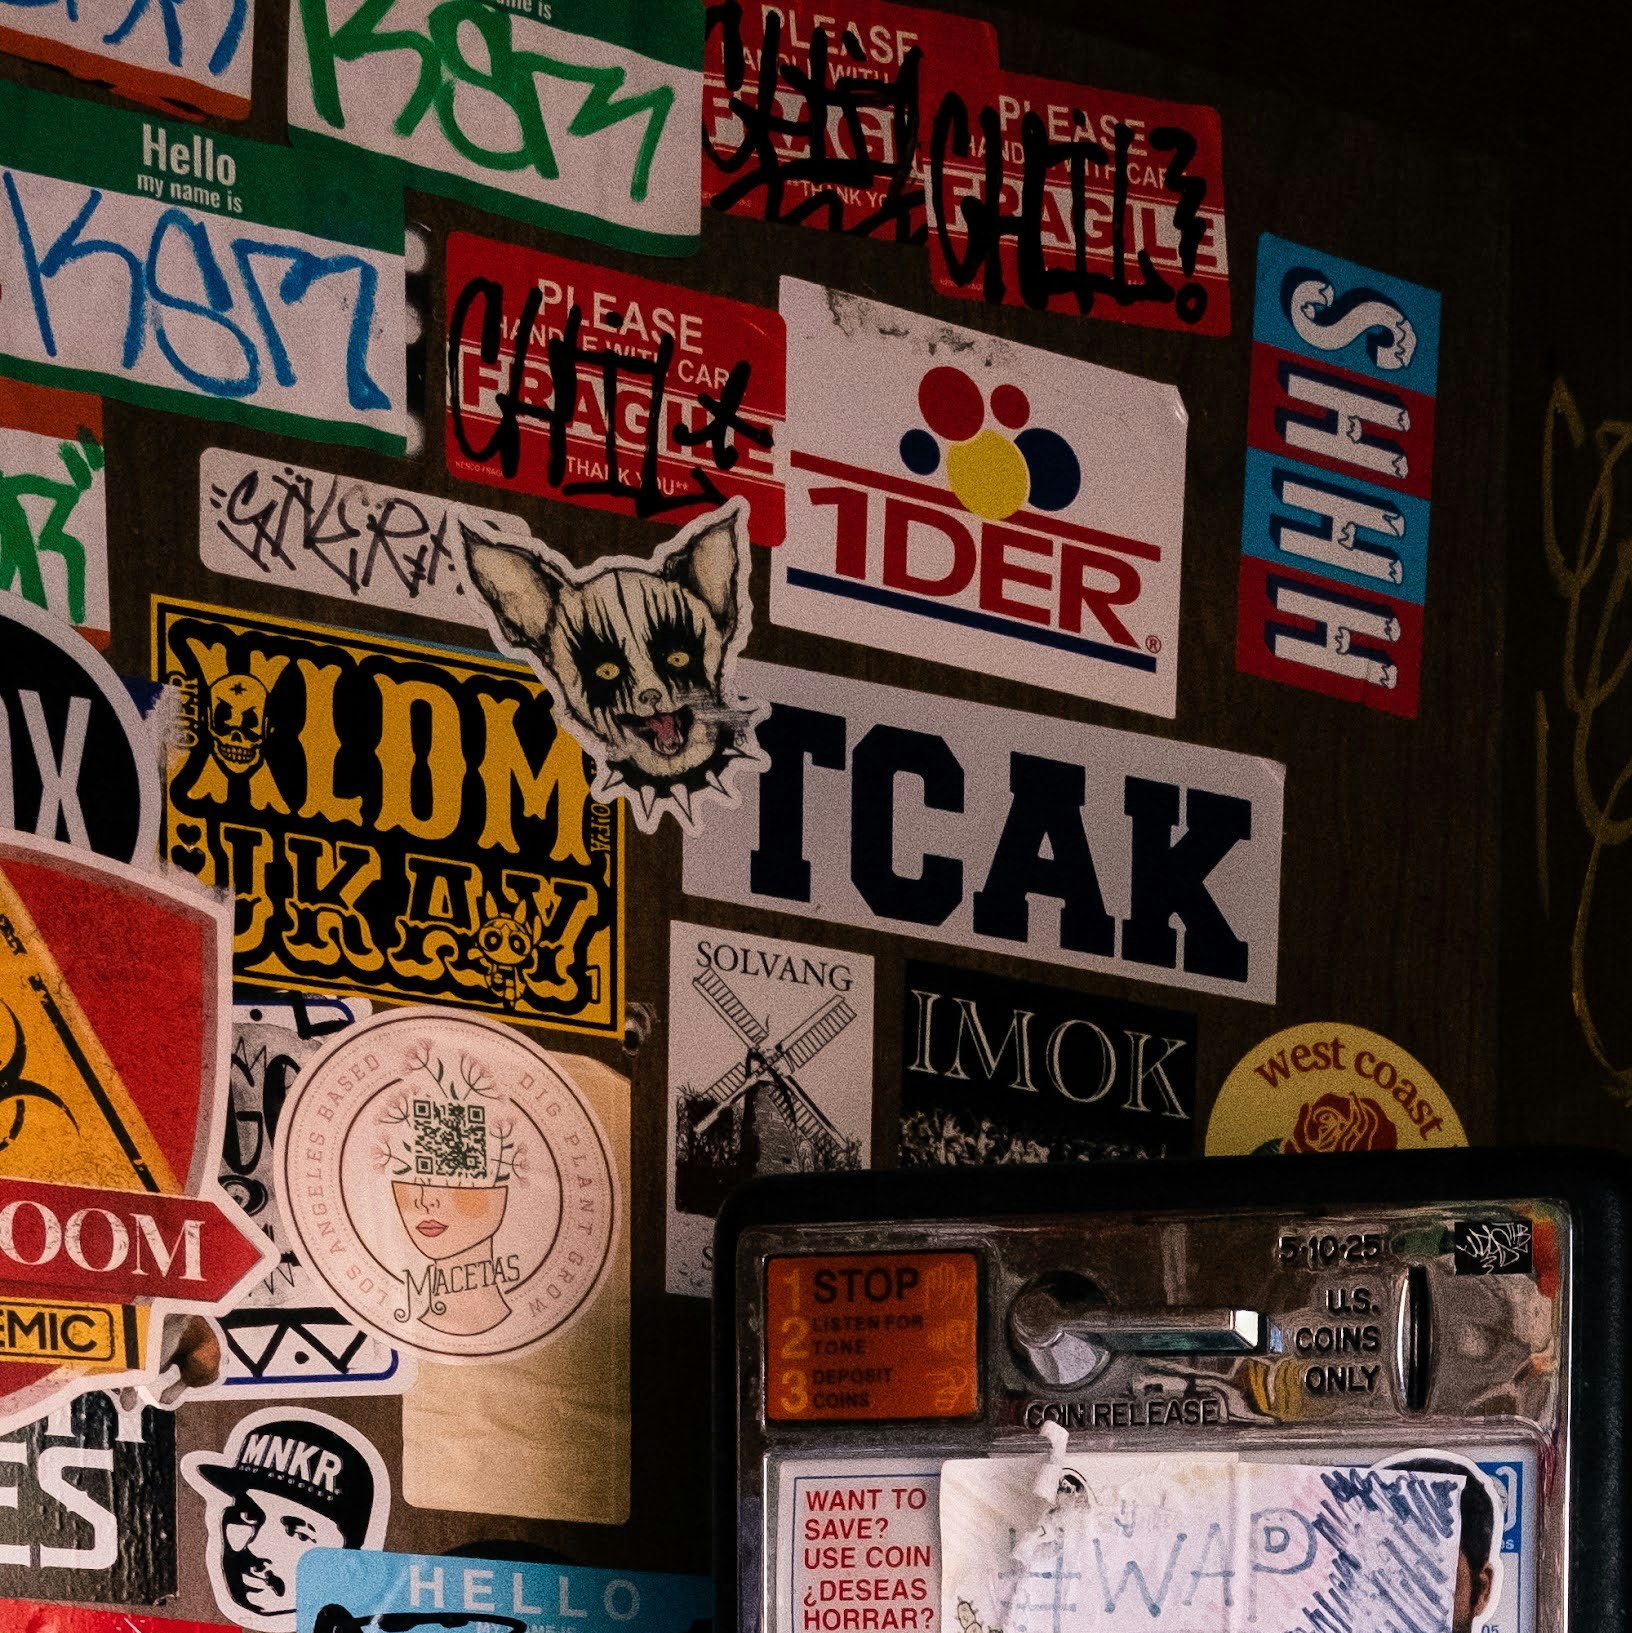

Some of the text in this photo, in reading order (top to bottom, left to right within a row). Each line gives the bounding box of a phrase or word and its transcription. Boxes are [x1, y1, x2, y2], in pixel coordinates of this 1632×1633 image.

[142, 122, 237, 187] Hello
[137, 173, 244, 213] my name is
[537, 277, 704, 355] PLEASE
[1266, 267, 1418, 691] SHHH
[809, 486, 1142, 650] 1DER
[695, 940, 853, 994] SOLVANG
[908, 986, 1192, 1121] IMOK
[1254, 1039, 1444, 1142] west coast
[305, 1053, 381, 1256] ANGELES BASED
[563, 1132, 597, 1236] PLANT
[393, 1254, 521, 1323] MACETAS
[812, 1266, 920, 1305] STOP
[1326, 1287, 1381, 1316] U.S.
[812, 1337, 868, 1358] TONE
[1295, 1325, 1381, 1355] COINS
[1304, 1364, 1382, 1394] ONLY
[1025, 1398, 1221, 1430] COIN RELEASE
[807, 1487, 928, 1513] WANT TO
[805, 1516, 890, 1543] SAVE?
[804, 1545, 933, 1571] USE COIN
[409, 1562, 641, 1623] HELLO
[803, 1577, 928, 1606] ¿DESEAS
[803, 1606, 934, 1633] HORRAR?
